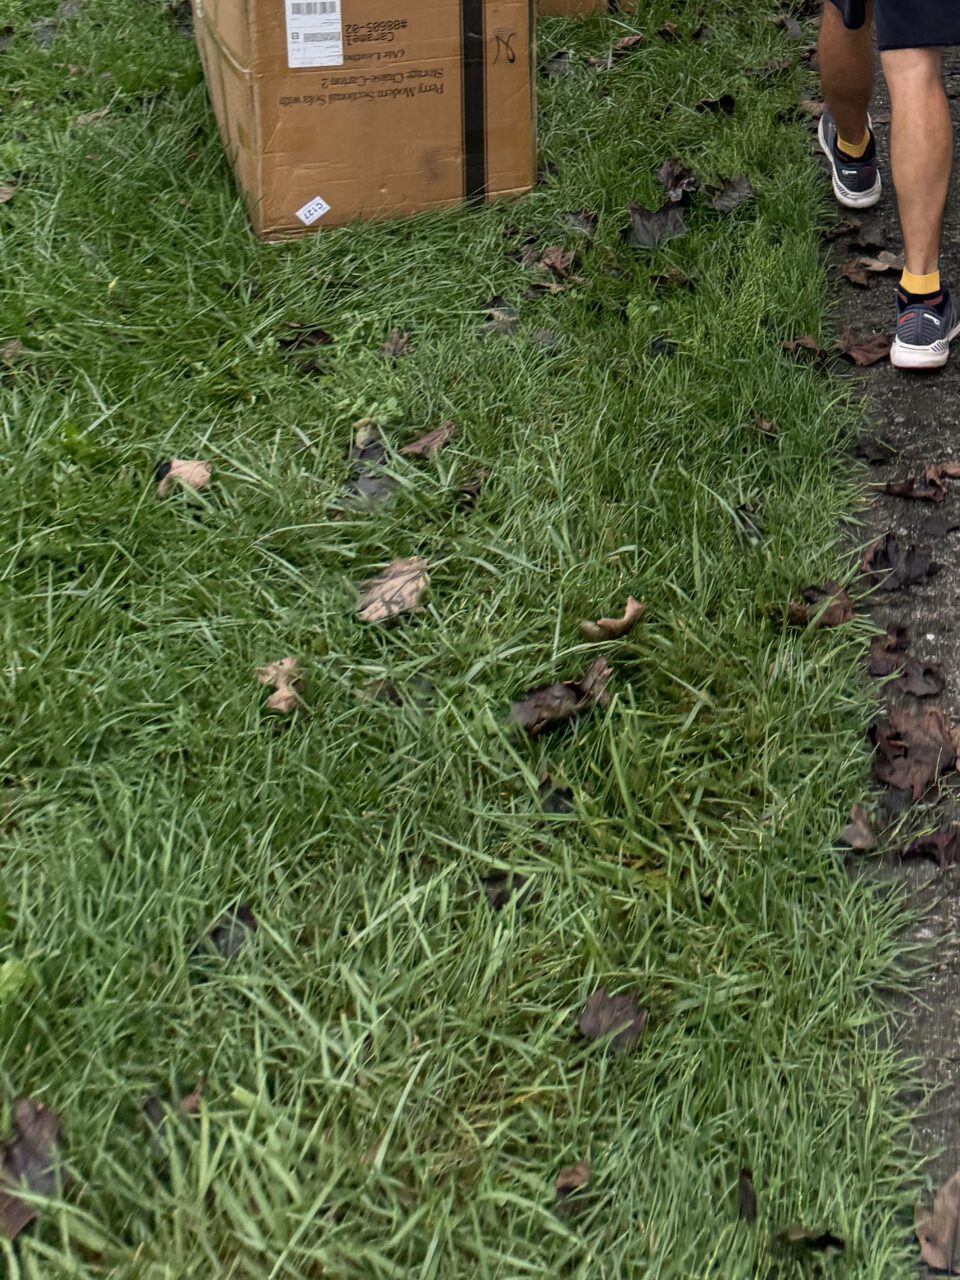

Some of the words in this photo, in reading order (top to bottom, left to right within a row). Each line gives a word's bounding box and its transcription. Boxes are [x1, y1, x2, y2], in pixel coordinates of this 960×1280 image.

[345, 31, 395, 46] Caramel
[376, 86, 416, 100] Modern
[418, 82, 445, 96] Perry
[303, 202, 324, 220] C127
